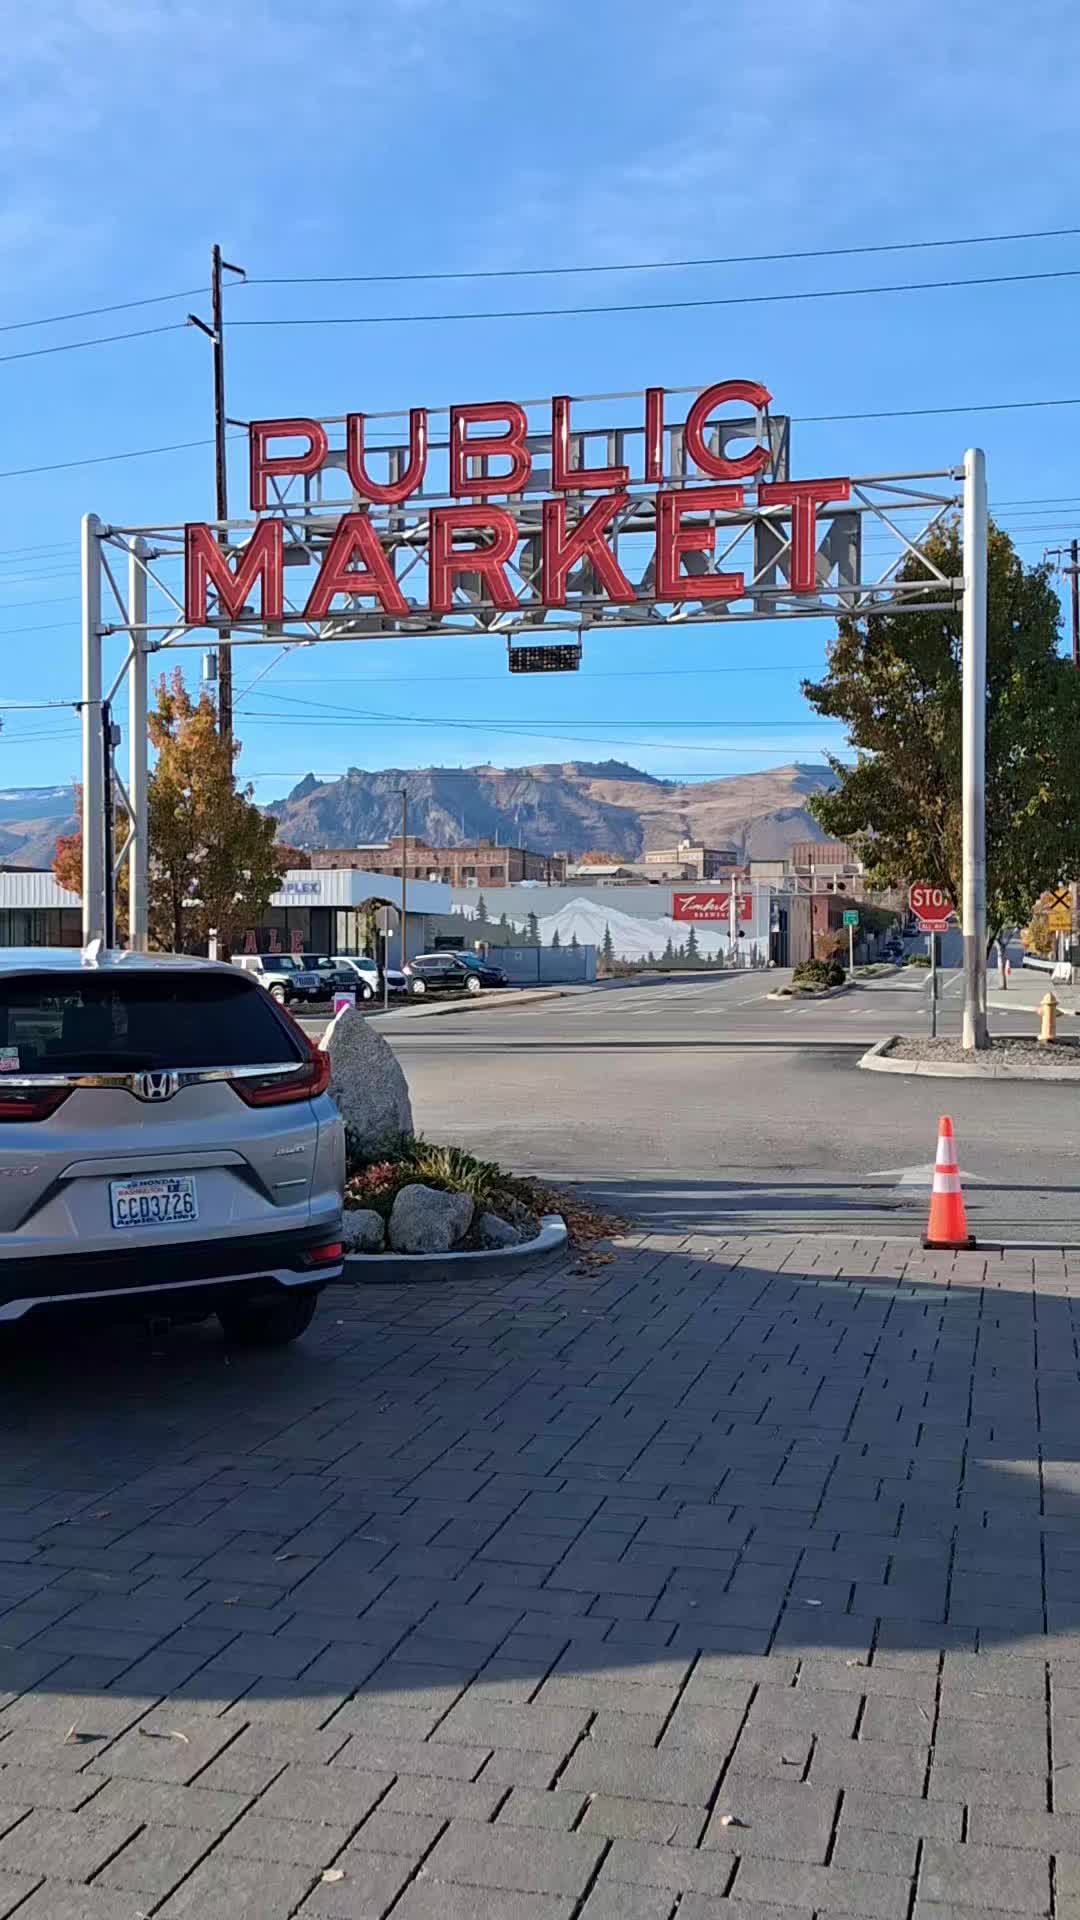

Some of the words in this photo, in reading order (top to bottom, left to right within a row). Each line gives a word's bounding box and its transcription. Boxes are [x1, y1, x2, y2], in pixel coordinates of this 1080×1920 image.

[249, 380, 773, 510] PUBLIC
[184, 477, 851, 624] MARKET
[510, 646, 576, 670] OPEN
[139, 1179, 176, 1187] HONDA
[116, 1193, 193, 1219] CCD3726
